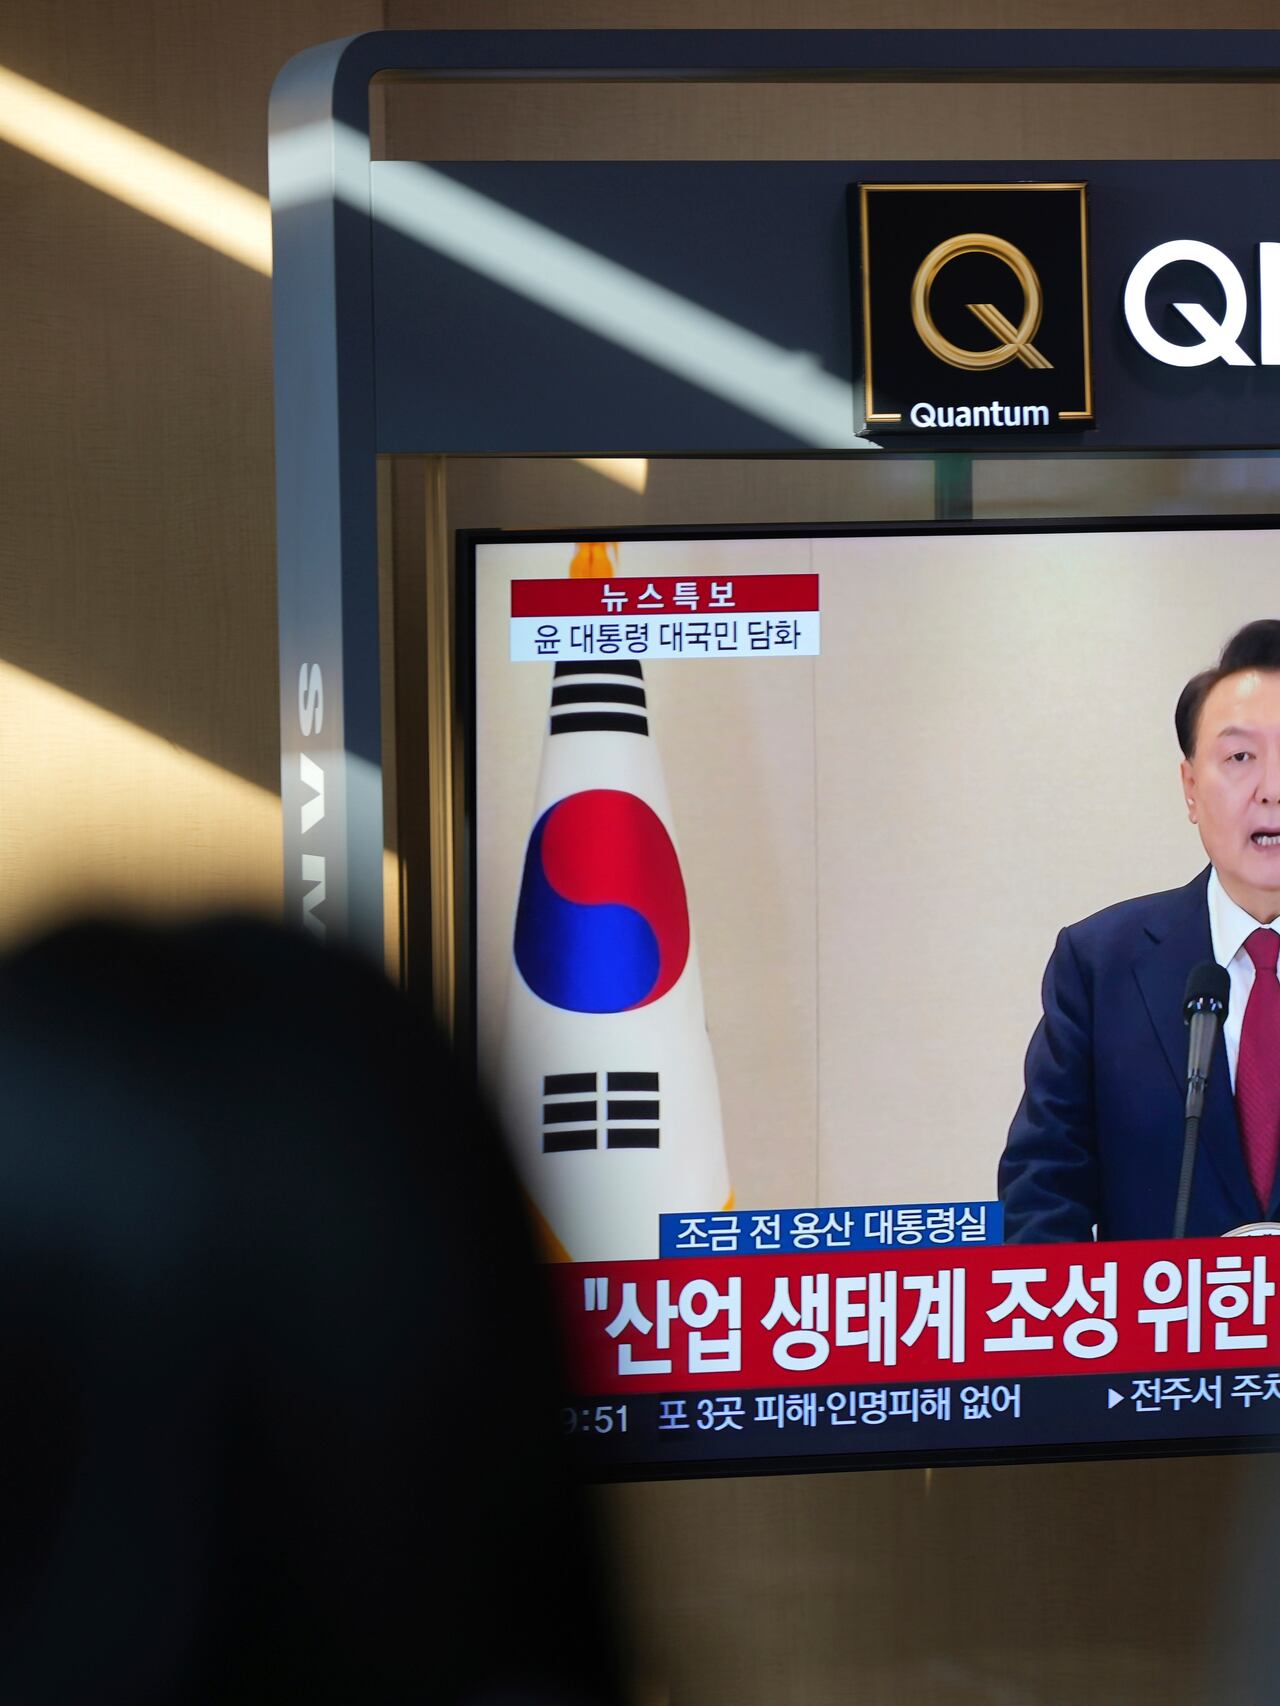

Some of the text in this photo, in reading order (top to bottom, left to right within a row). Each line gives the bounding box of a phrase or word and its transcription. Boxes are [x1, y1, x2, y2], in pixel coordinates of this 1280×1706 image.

[911, 233, 1055, 371] Q
[910, 401, 1049, 431] Quantum
[534, 619, 802, 655] 윤 대통령 대국민 담화
[675, 1206, 987, 1252] 조금 전 용산 대통령실
[583, 1277, 742, 1376] "산업
[761, 1267, 966, 1372] 생태계
[983, 1262, 1119, 1360] 조성
[1138, 1255, 1276, 1354] 위한
[658, 1384, 1022, 1431] 포 3곳 피해·인명피해 없어
[1130, 1375, 1223, 1413] 전주서
